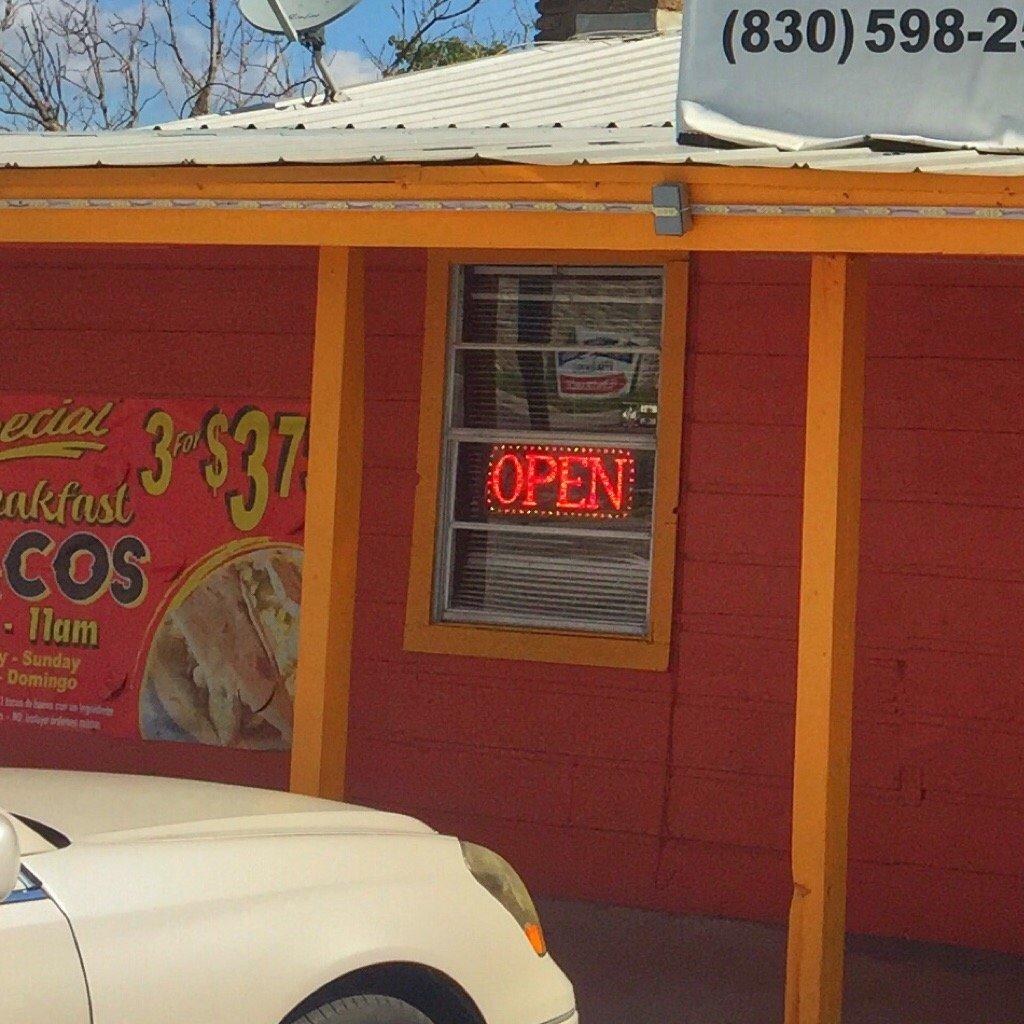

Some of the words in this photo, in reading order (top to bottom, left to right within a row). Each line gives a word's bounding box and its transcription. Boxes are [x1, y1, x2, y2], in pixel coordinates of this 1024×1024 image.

[0, 398, 114, 443] ecial
[140, 411, 173, 496] 3
[204, 408, 307, 532] $37
[493, 454, 628, 510] OPEN
[0, 529, 151, 608] COS
[29, 606, 98, 647] 11am
[8, 668, 78, 693] Domingo
[23, 649, 81, 675] Sunday
